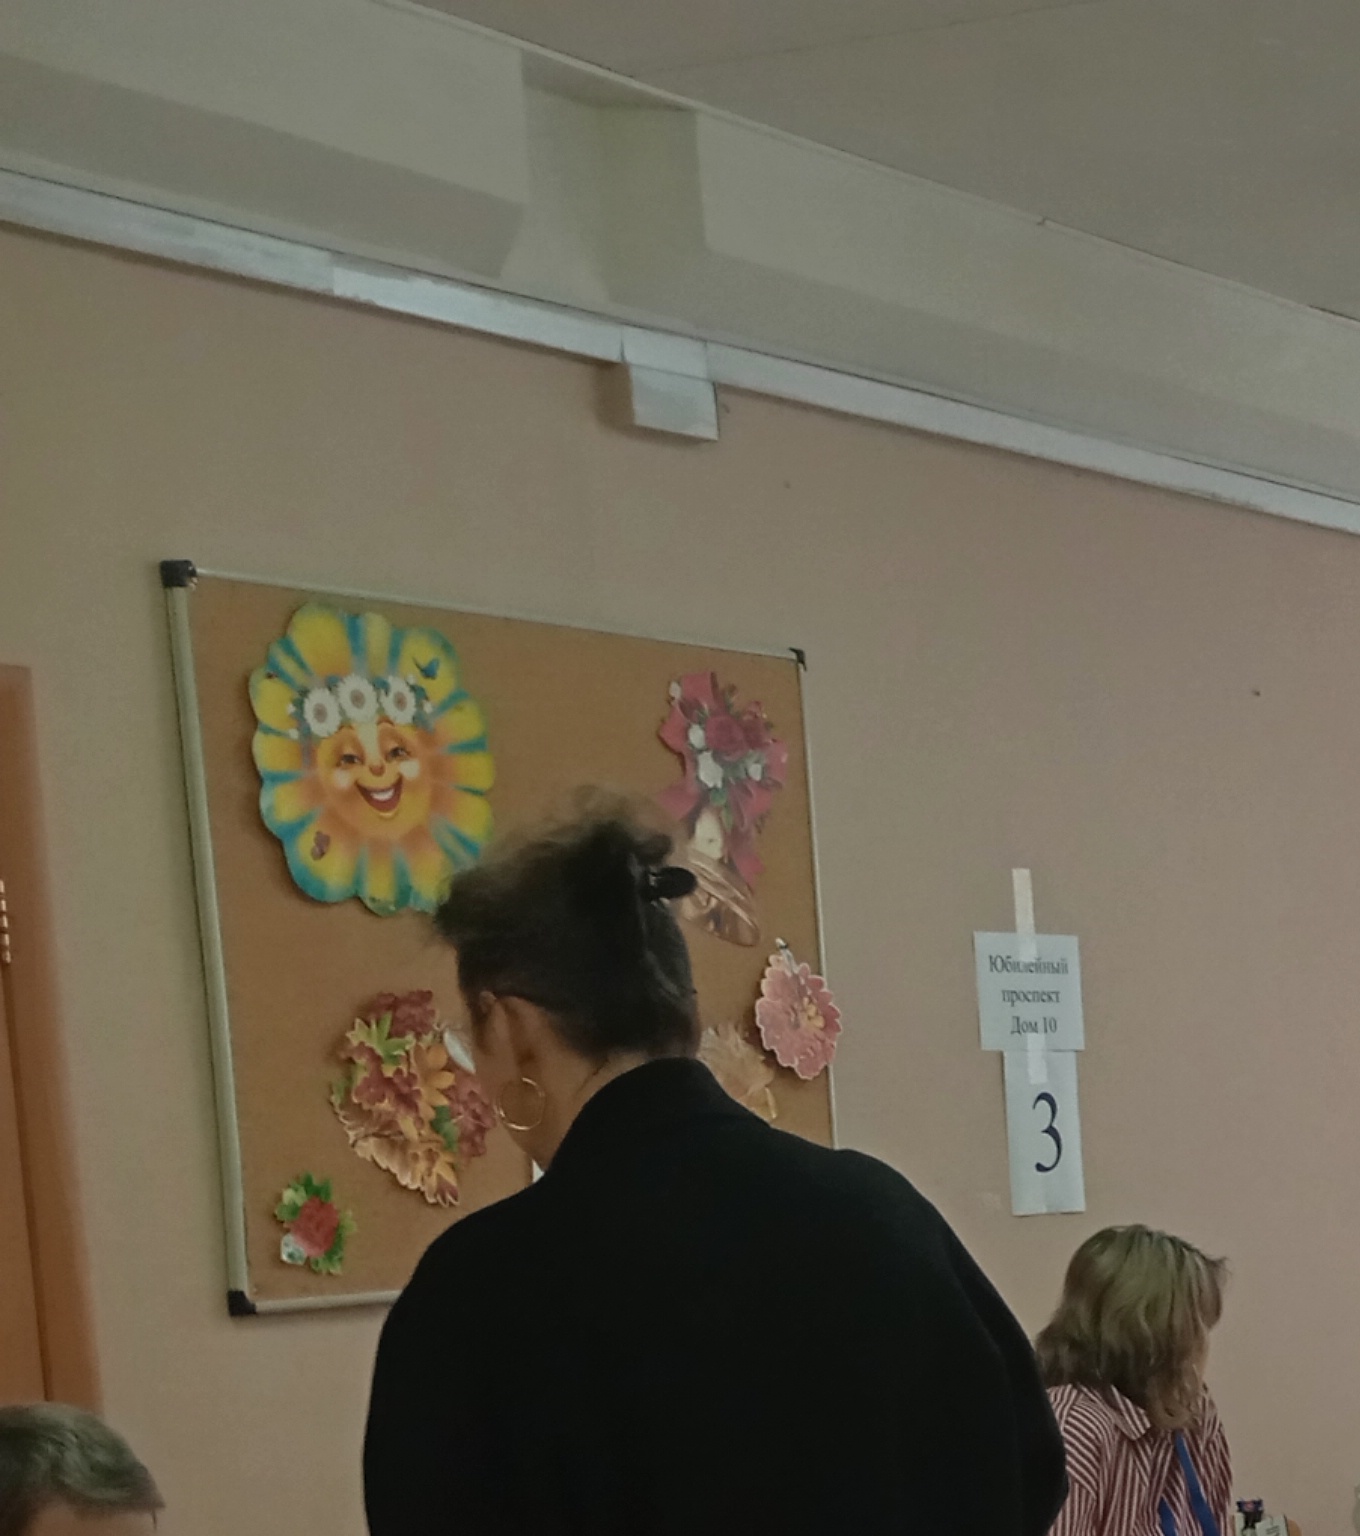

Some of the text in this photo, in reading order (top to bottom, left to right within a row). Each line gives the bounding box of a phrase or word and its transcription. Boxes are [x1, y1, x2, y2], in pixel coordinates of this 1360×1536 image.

[988, 953, 1069, 975] Юбилейный
[1001, 989, 1061, 1007] проспект
[1010, 1015, 1057, 1035] Дом 10
[1032, 1092, 1062, 1173] 3
